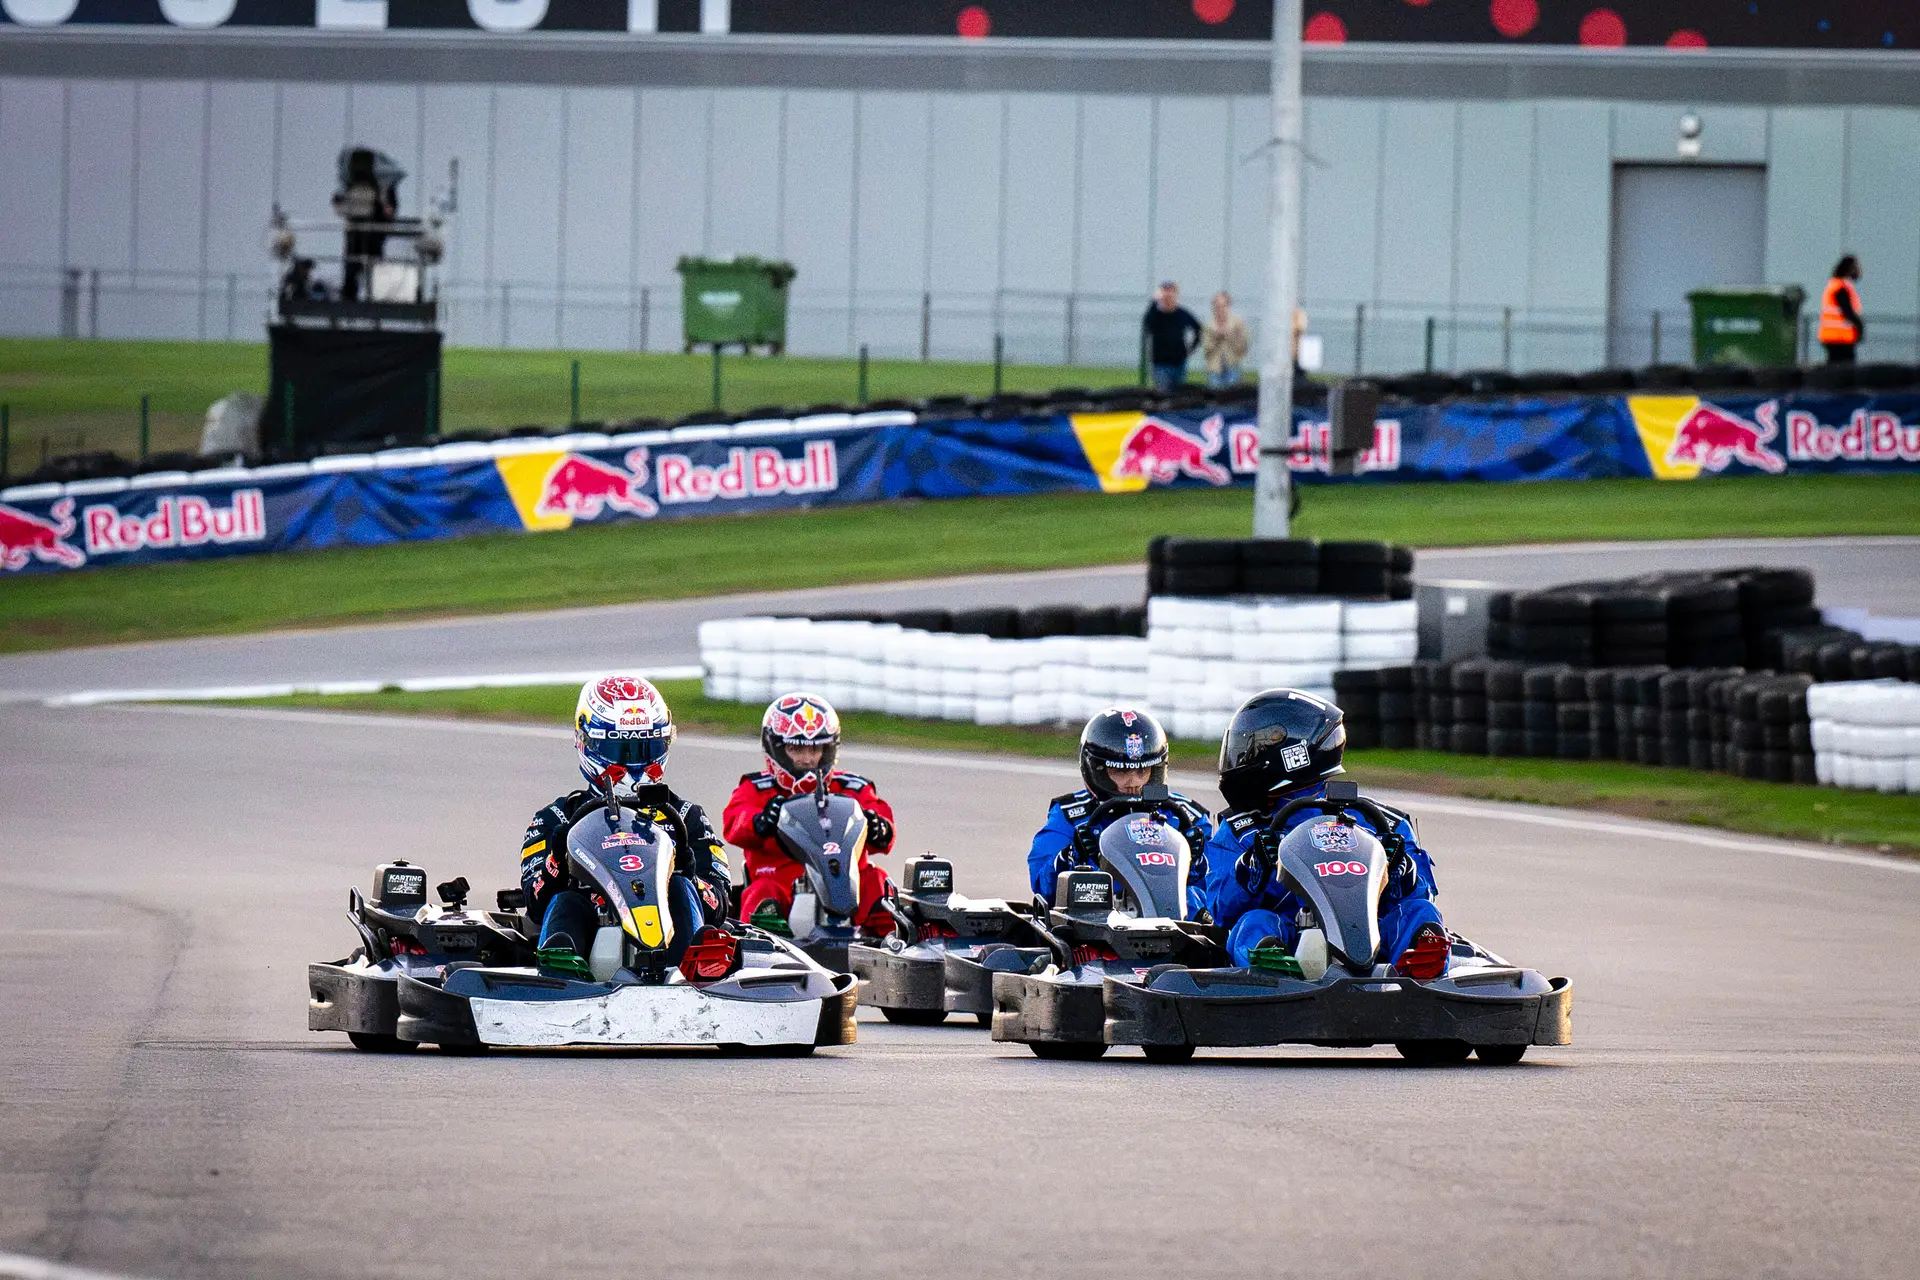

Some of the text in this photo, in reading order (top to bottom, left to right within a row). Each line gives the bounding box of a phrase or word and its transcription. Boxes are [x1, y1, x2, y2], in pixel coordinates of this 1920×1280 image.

[1786, 409, 1920, 461] Red Bu
[1230, 421, 1316, 473] Rd
[657, 441, 837, 502] Red Bull
[85, 490, 265, 554] Red Bull
[636, 716, 650, 725] Bull
[608, 729, 660, 739] ORACLE
[1105, 760, 1124, 768] GIVES
[1285, 752, 1308, 769] ICE
[823, 842, 841, 855] 2
[619, 855, 644, 871] 3
[1136, 852, 1176, 866] 101
[1314, 861, 1368, 877] 100
